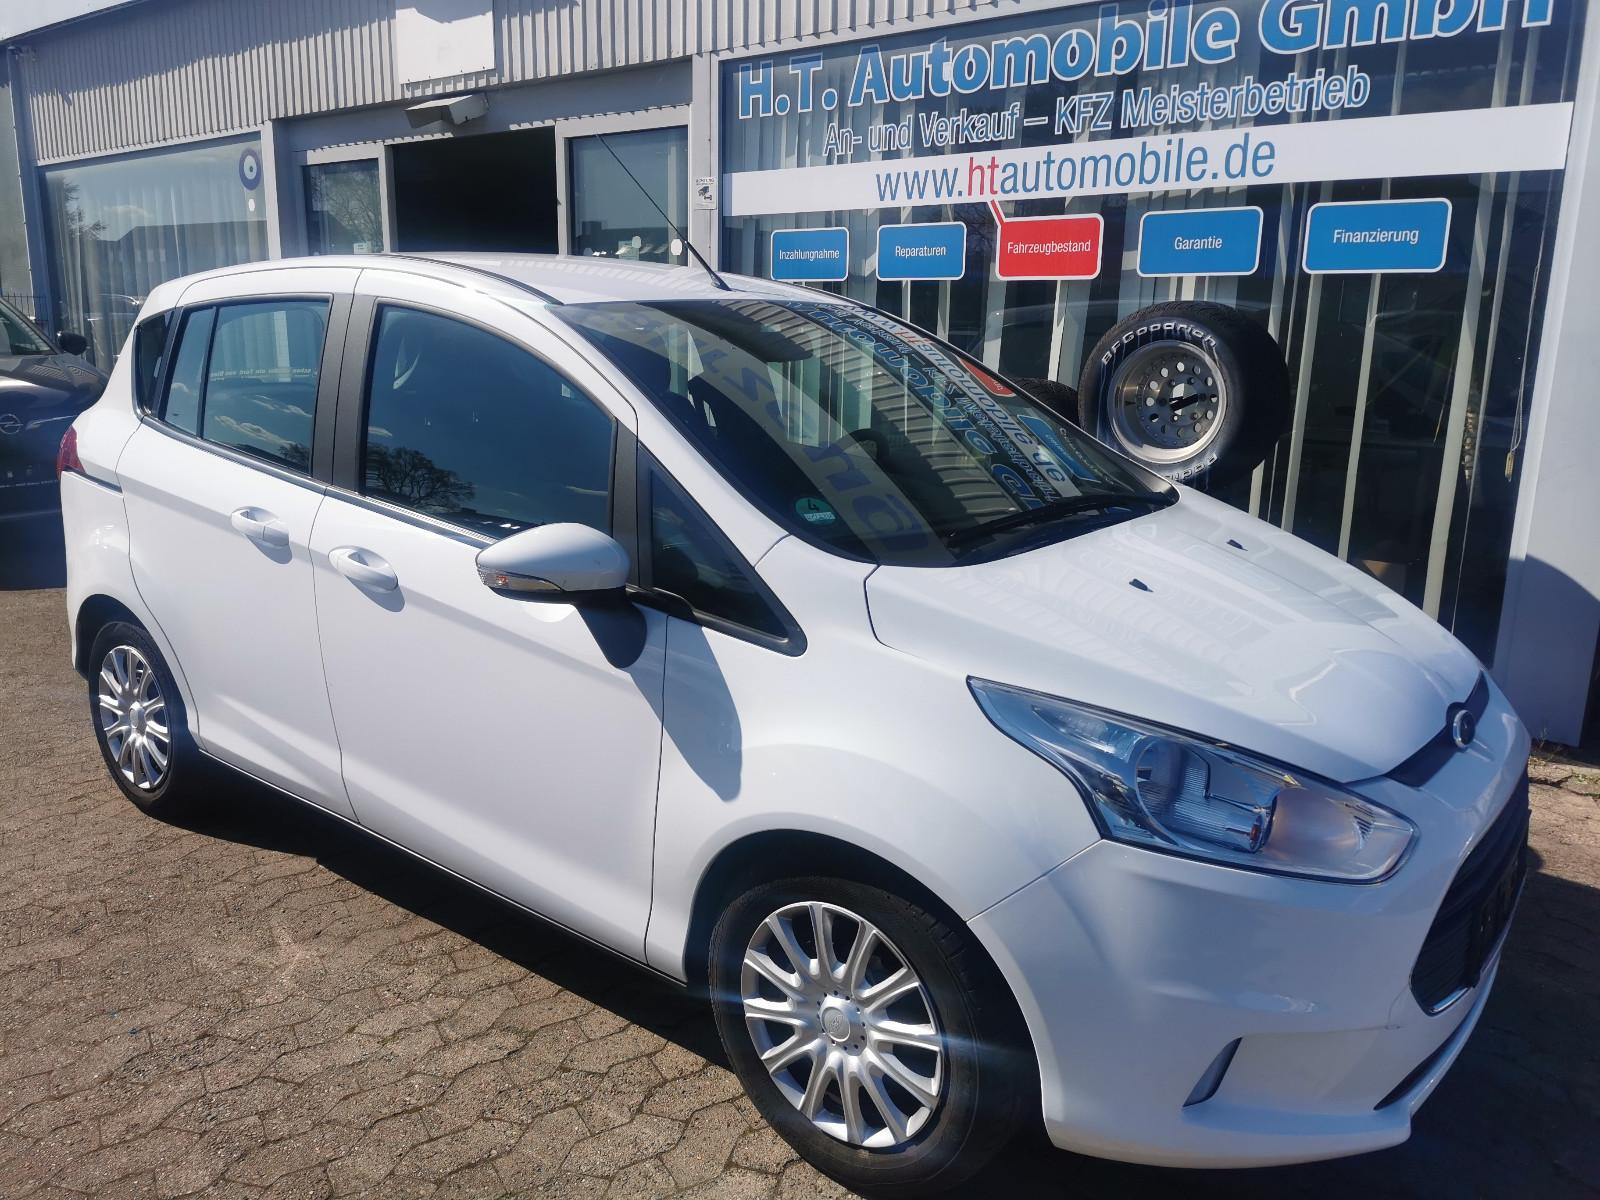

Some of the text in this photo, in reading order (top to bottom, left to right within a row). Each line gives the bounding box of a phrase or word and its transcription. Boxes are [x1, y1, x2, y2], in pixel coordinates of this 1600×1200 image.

[847, 0, 1241, 107] Automobile
[822, 122, 863, 157] An-
[868, 115, 913, 153] und
[919, 101, 1021, 147] Verkauf
[1054, 91, 1114, 135] KFZ
[1120, 64, 1371, 128] Meisterbetrieb
[876, 132, 1277, 202] www.htautomobile.de
[1174, 235, 1223, 251] Garantie
[1333, 228, 1419, 245] Finanzierung
[778, 248, 840, 262] Inzahlungnahme
[895, 244, 947, 258] Reparaturen
[1007, 239, 1091, 256] Fahrzeugbestand
